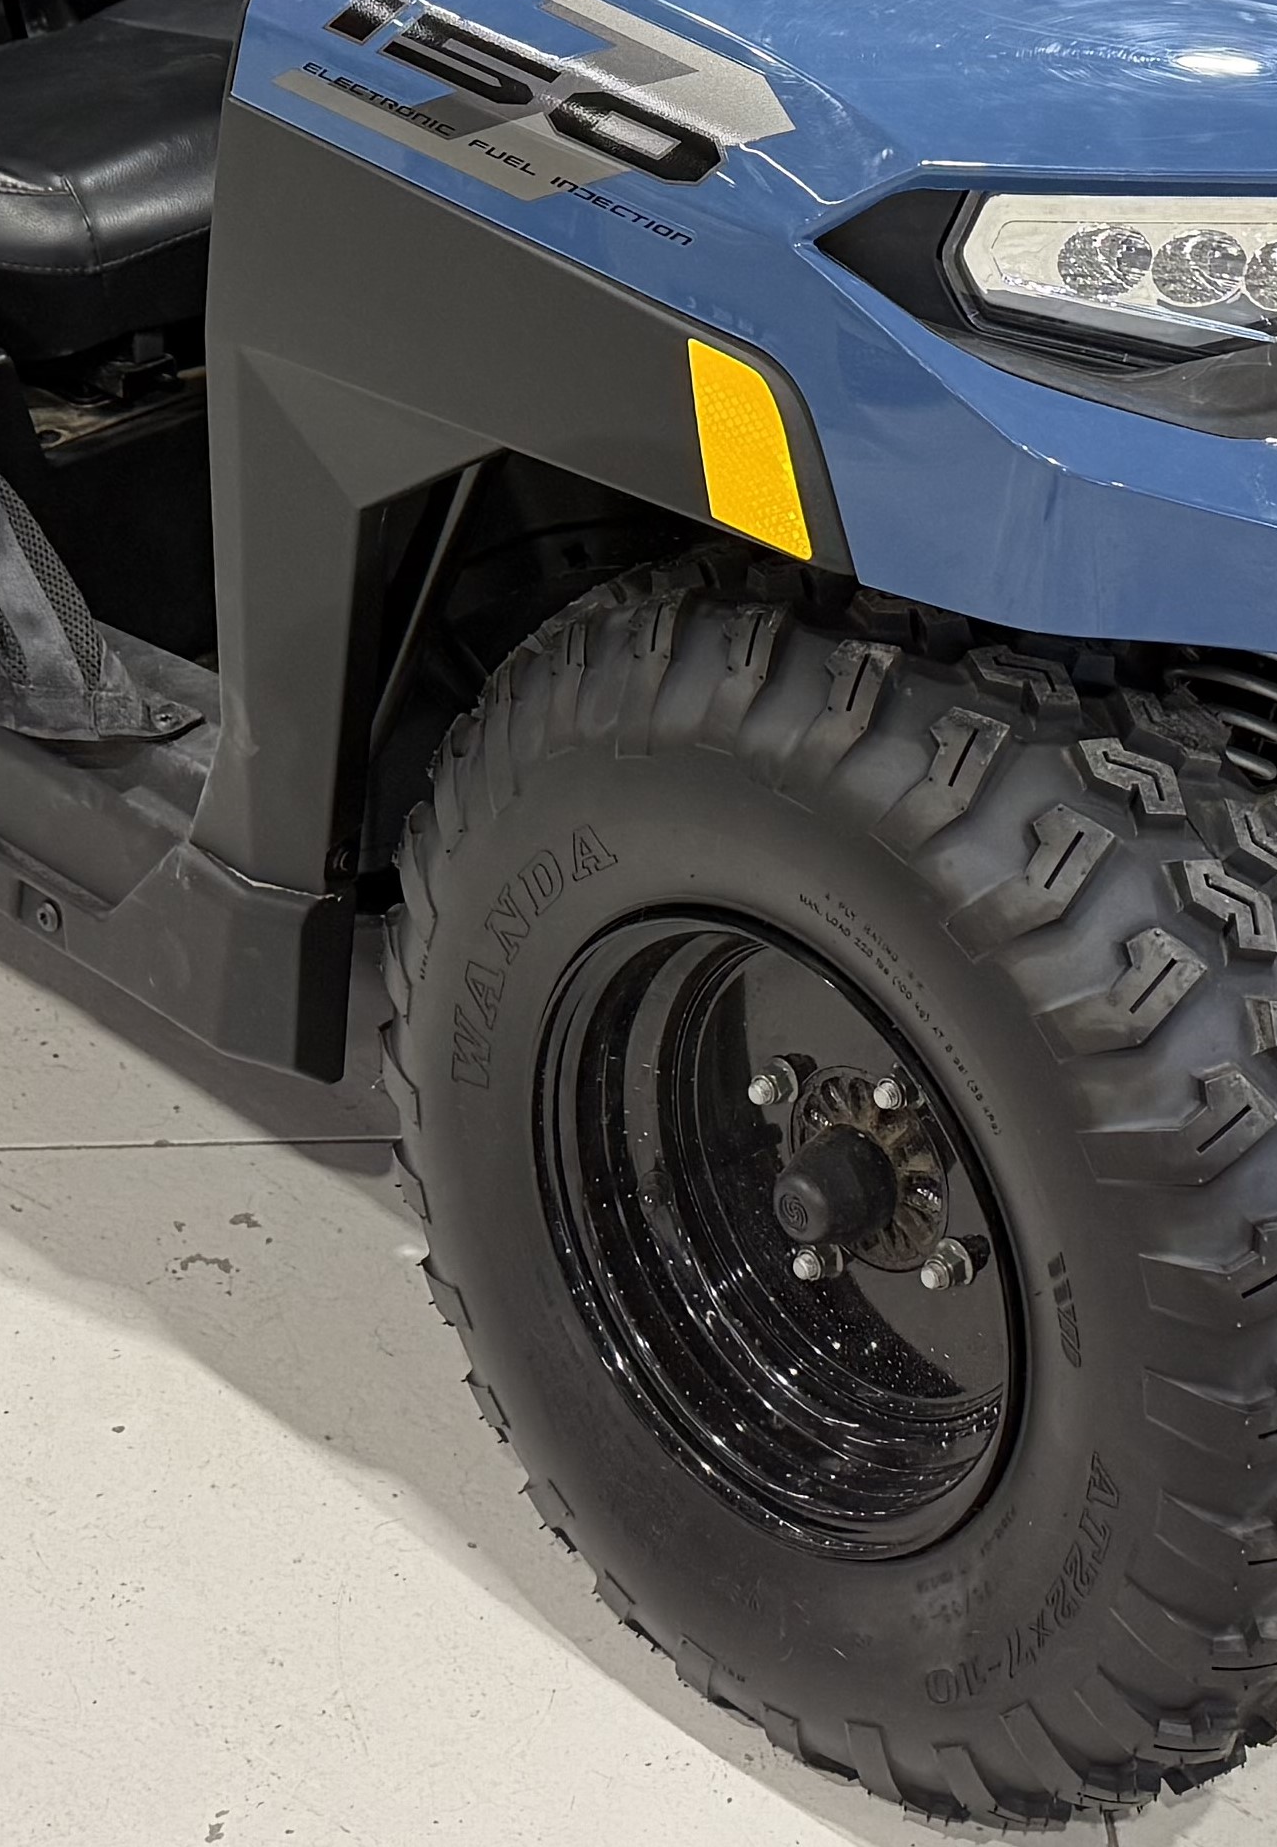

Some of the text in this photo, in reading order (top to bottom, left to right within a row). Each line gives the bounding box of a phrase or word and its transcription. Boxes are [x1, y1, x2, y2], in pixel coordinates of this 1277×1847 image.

[301, 61, 693, 247] ELECTRONIC FUEL INJECTION
[451, 824, 618, 1090] WANDA
